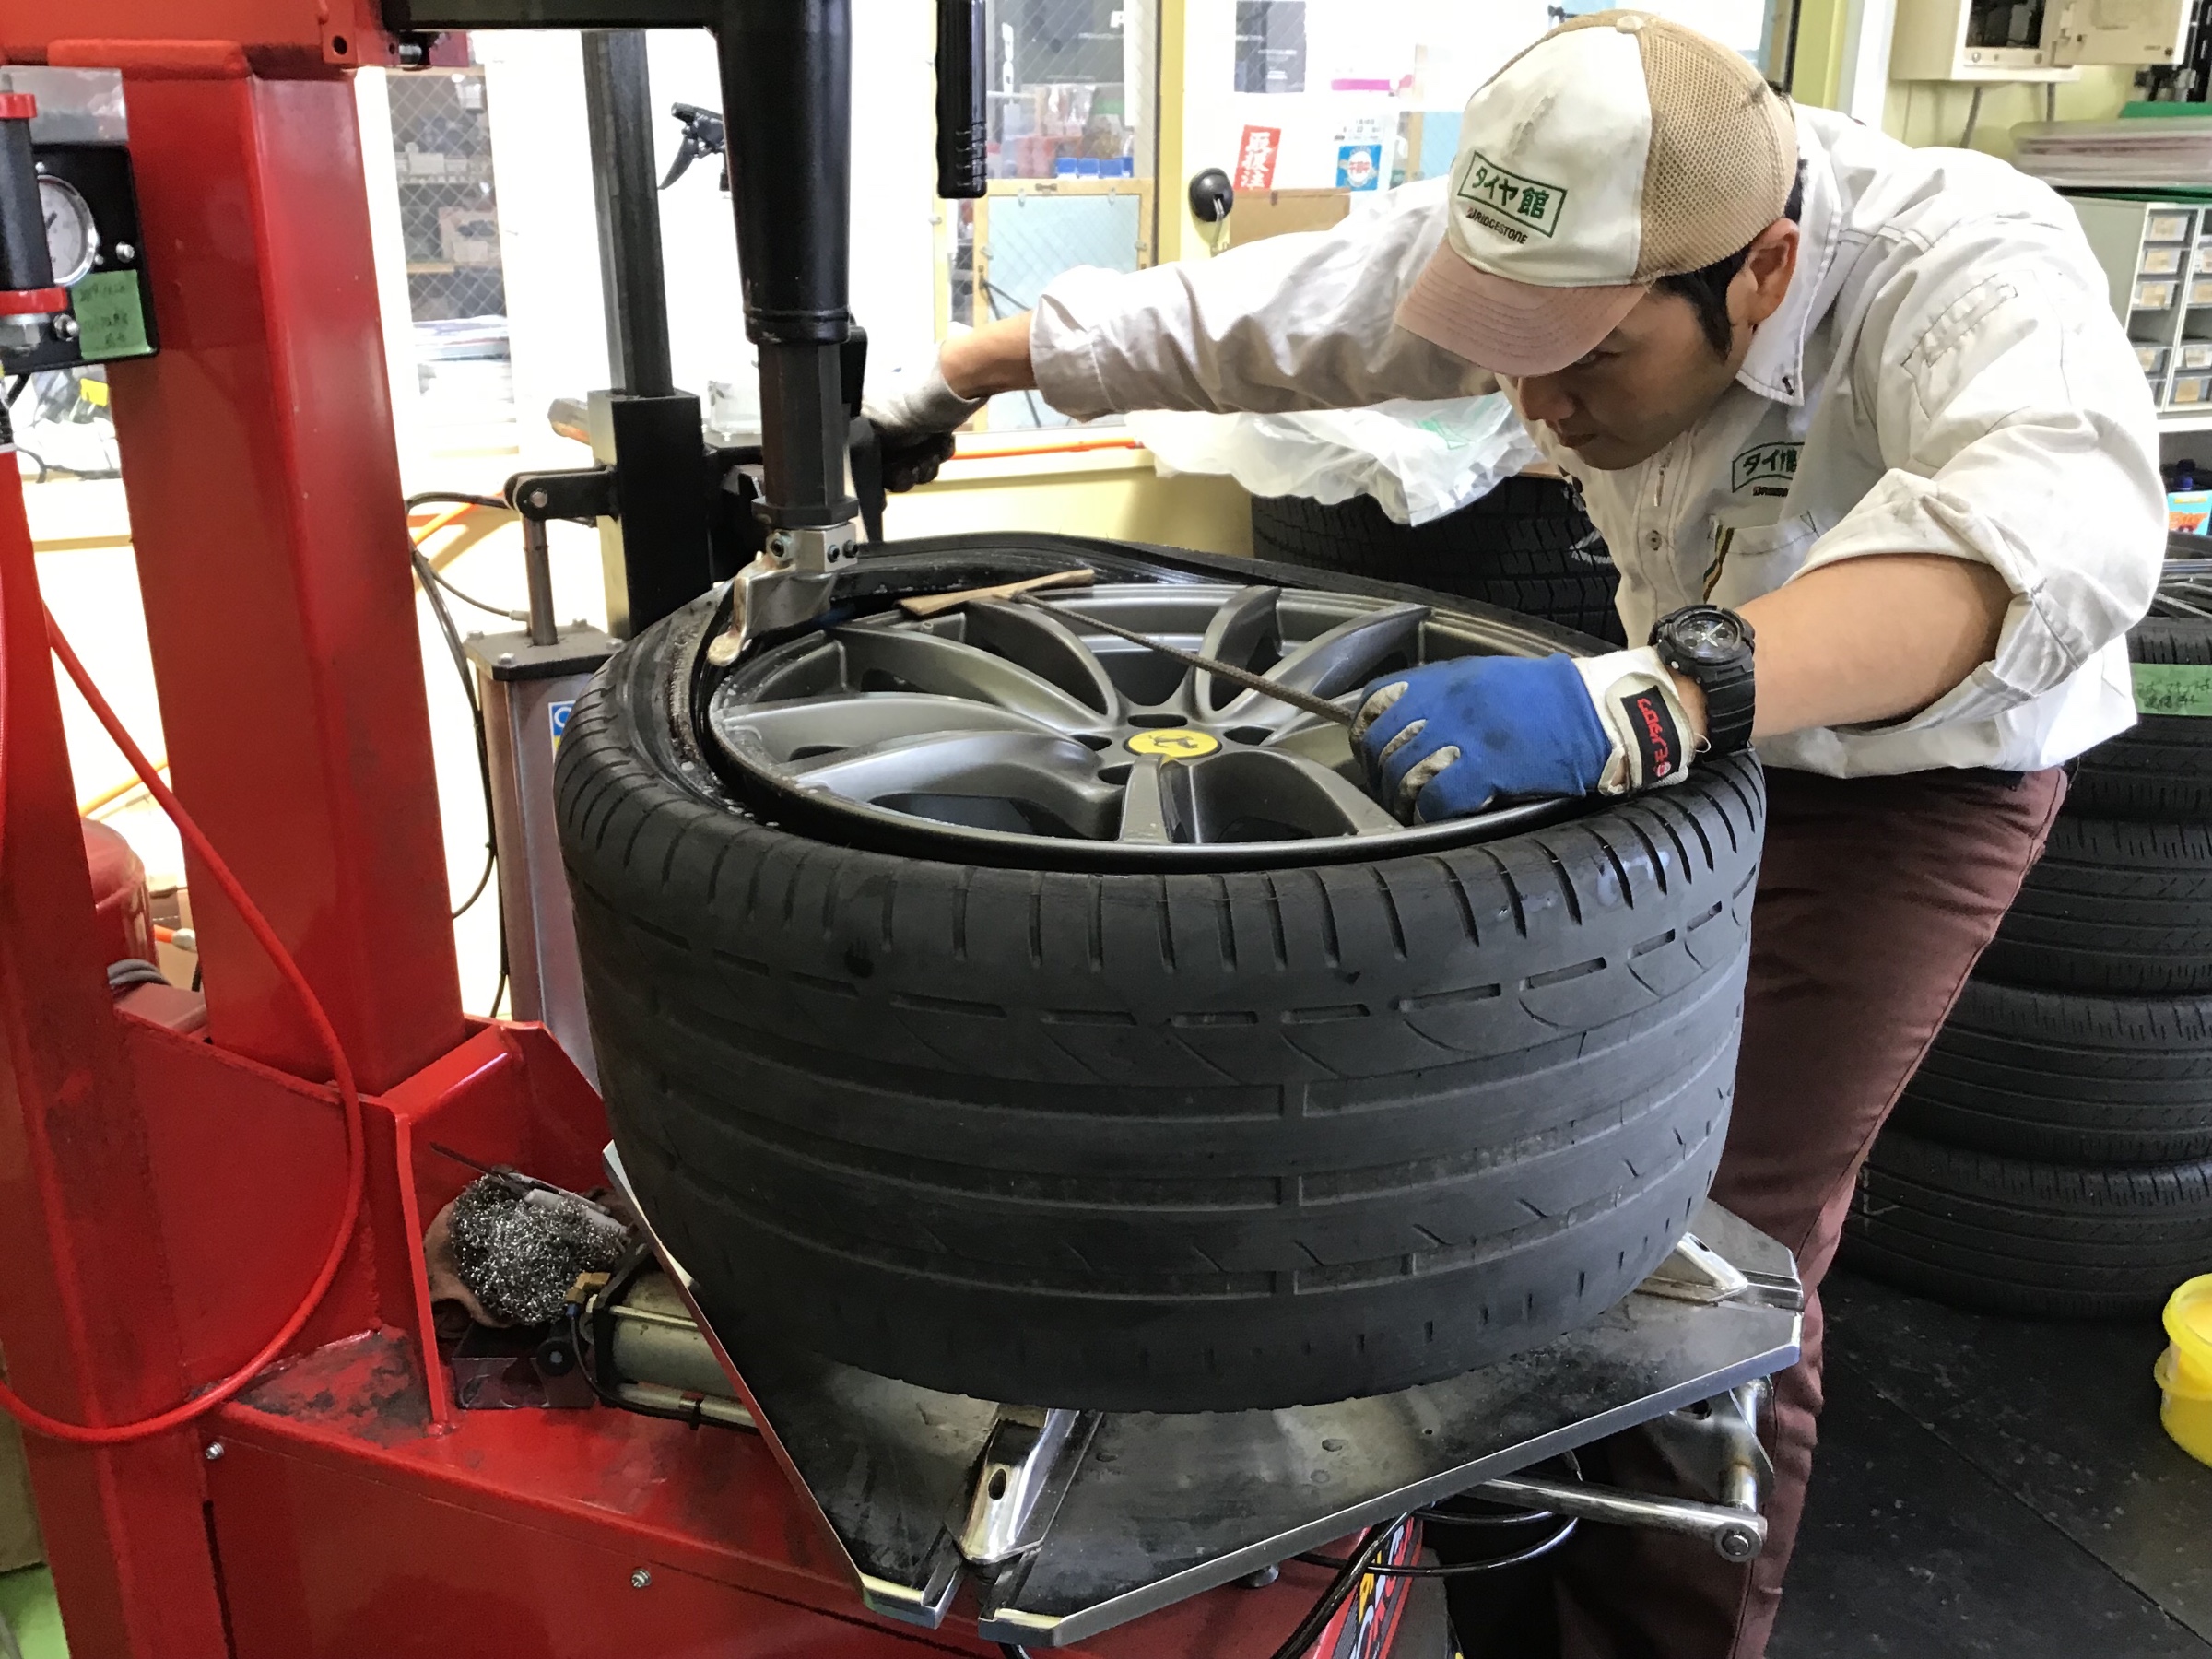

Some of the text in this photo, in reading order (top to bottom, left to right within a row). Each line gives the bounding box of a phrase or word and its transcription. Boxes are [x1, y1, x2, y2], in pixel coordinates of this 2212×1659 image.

[1472, 166, 1549, 219] タイヤ館
[1465, 206, 1529, 245] BRIDGESTONE
[1636, 698, 1669, 763] モノタロウ
